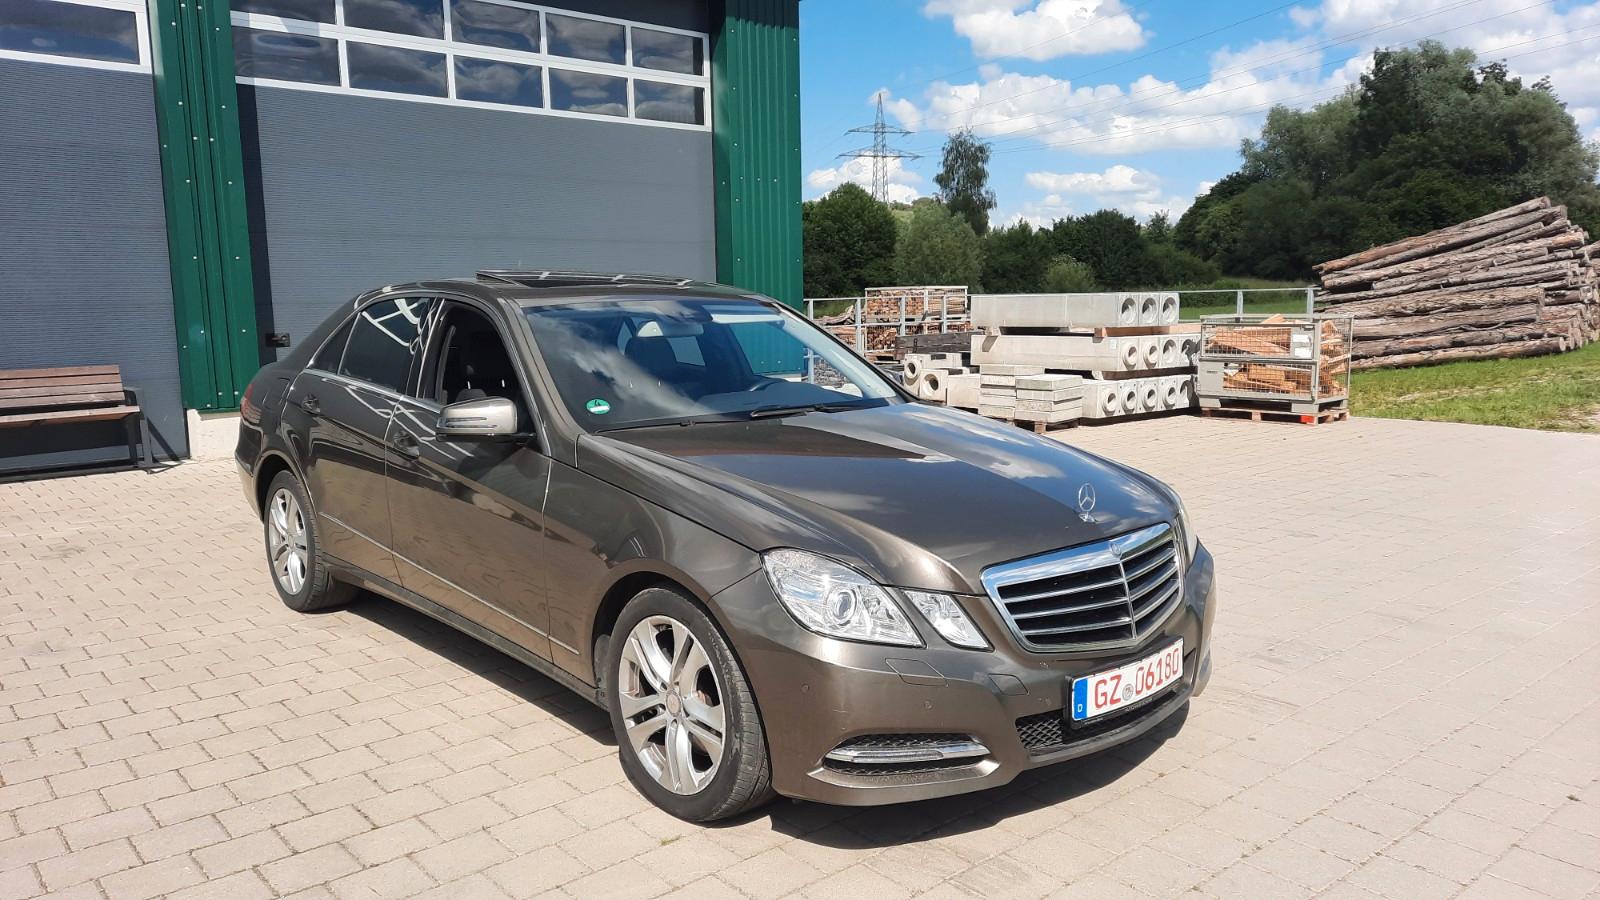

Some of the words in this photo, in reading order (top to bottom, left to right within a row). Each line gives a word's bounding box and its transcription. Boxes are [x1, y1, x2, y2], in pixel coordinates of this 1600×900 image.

[1077, 703, 1083, 713] D
[1094, 674, 1122, 709] GZ
[1135, 648, 1179, 695] 06180
